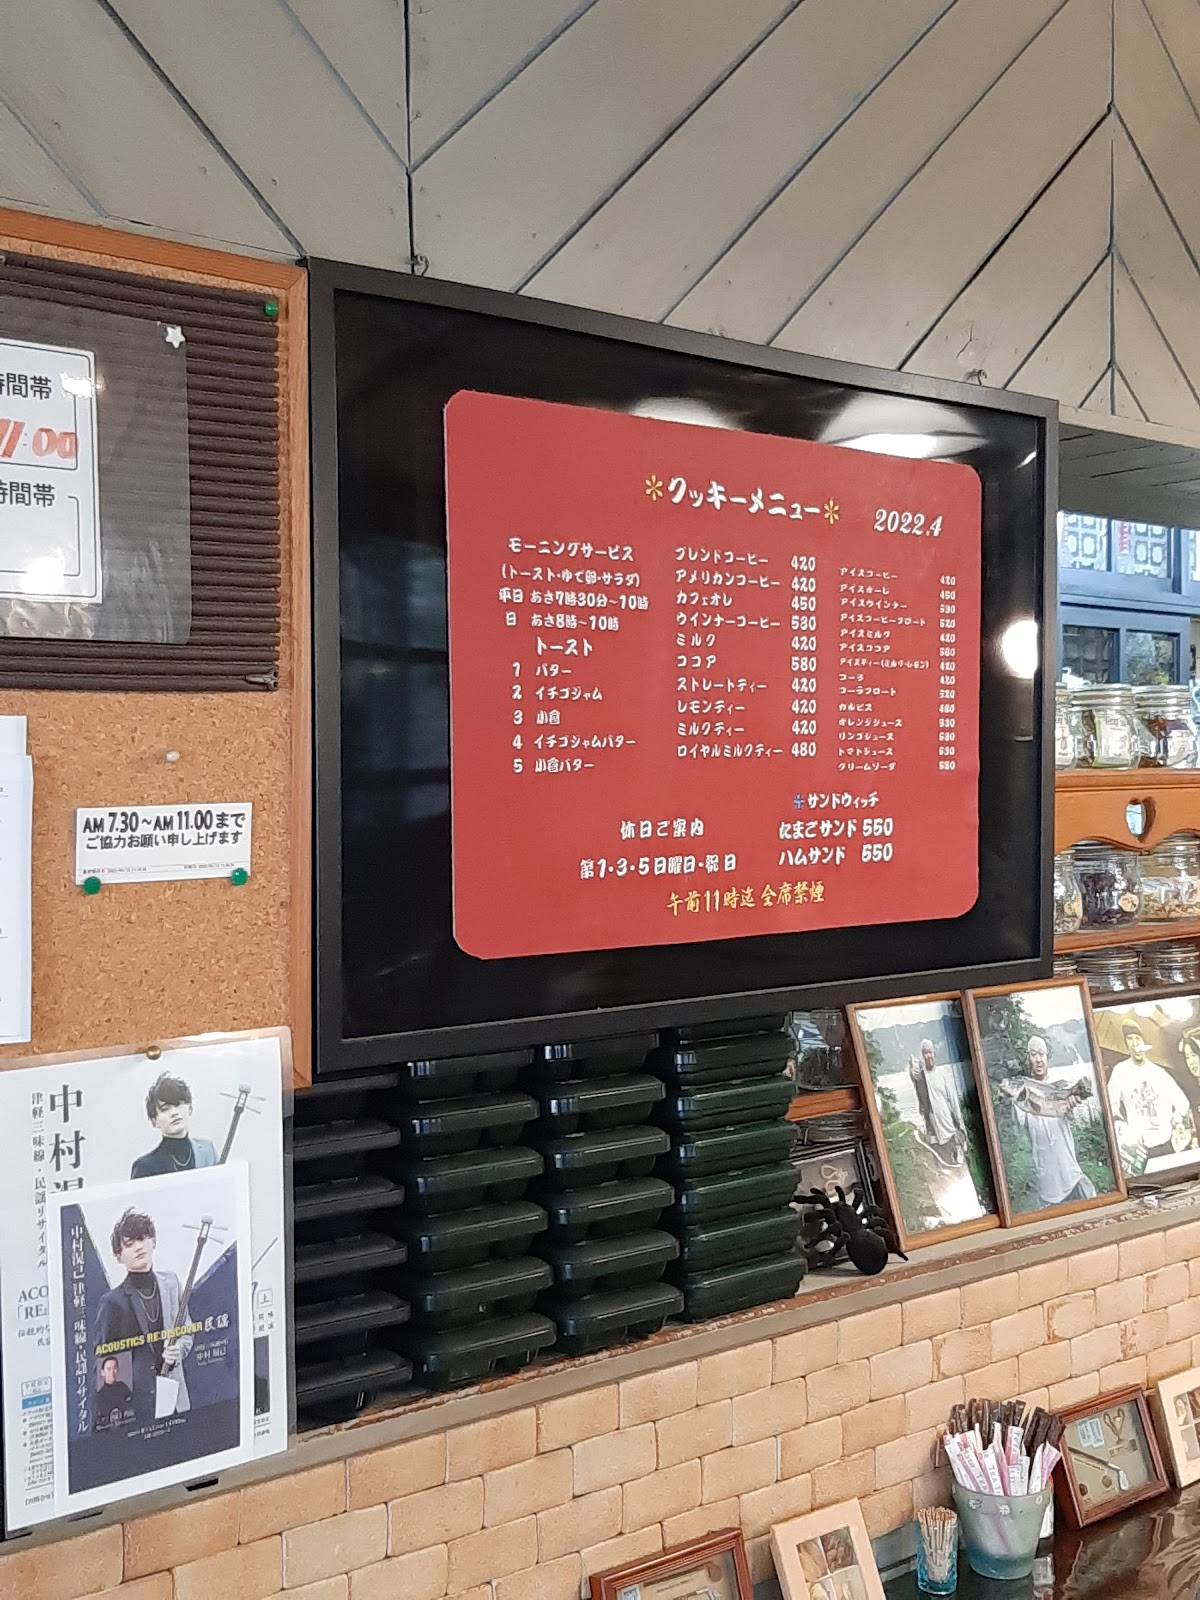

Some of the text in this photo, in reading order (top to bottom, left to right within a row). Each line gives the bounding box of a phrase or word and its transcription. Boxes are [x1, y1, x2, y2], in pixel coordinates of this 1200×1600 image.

[0, 373, 52, 400] 間帯
[668, 477, 821, 520] クッキーメニュー
[873, 508, 943, 537] 2022.4
[508, 537, 634, 562] モーニングサービス
[675, 546, 816, 572] ブレンドコーヒー 420
[675, 568, 817, 593] アメリカンコーヒー 420
[676, 589, 817, 612] カフェオレ 450
[676, 611, 781, 629] ウインナーコーヒー
[537, 636, 593, 657] トースト
[676, 632, 817, 652] ミルク 420
[535, 663, 572, 677] バター
[677, 654, 817, 673] ココア 580
[511, 684, 522, 700] 2
[677, 676, 817, 693] ストレートティー 420
[677, 698, 817, 715] レモンティー 420
[512, 709, 523, 725] 3
[677, 719, 817, 737] ミルクティー 420
[512, 733, 523, 749] 4
[677, 741, 817, 759] ロイヤルミルクティー 480
[512, 757, 523, 773] 5
[807, 791, 880, 810] サンドウィッチ
[620, 818, 704, 840] 休日ご案内
[778, 817, 894, 840] たまごサンド 550
[86, 831, 243, 850] ご協力お願い申し上げます
[777, 846, 848, 867] ハムサンド
